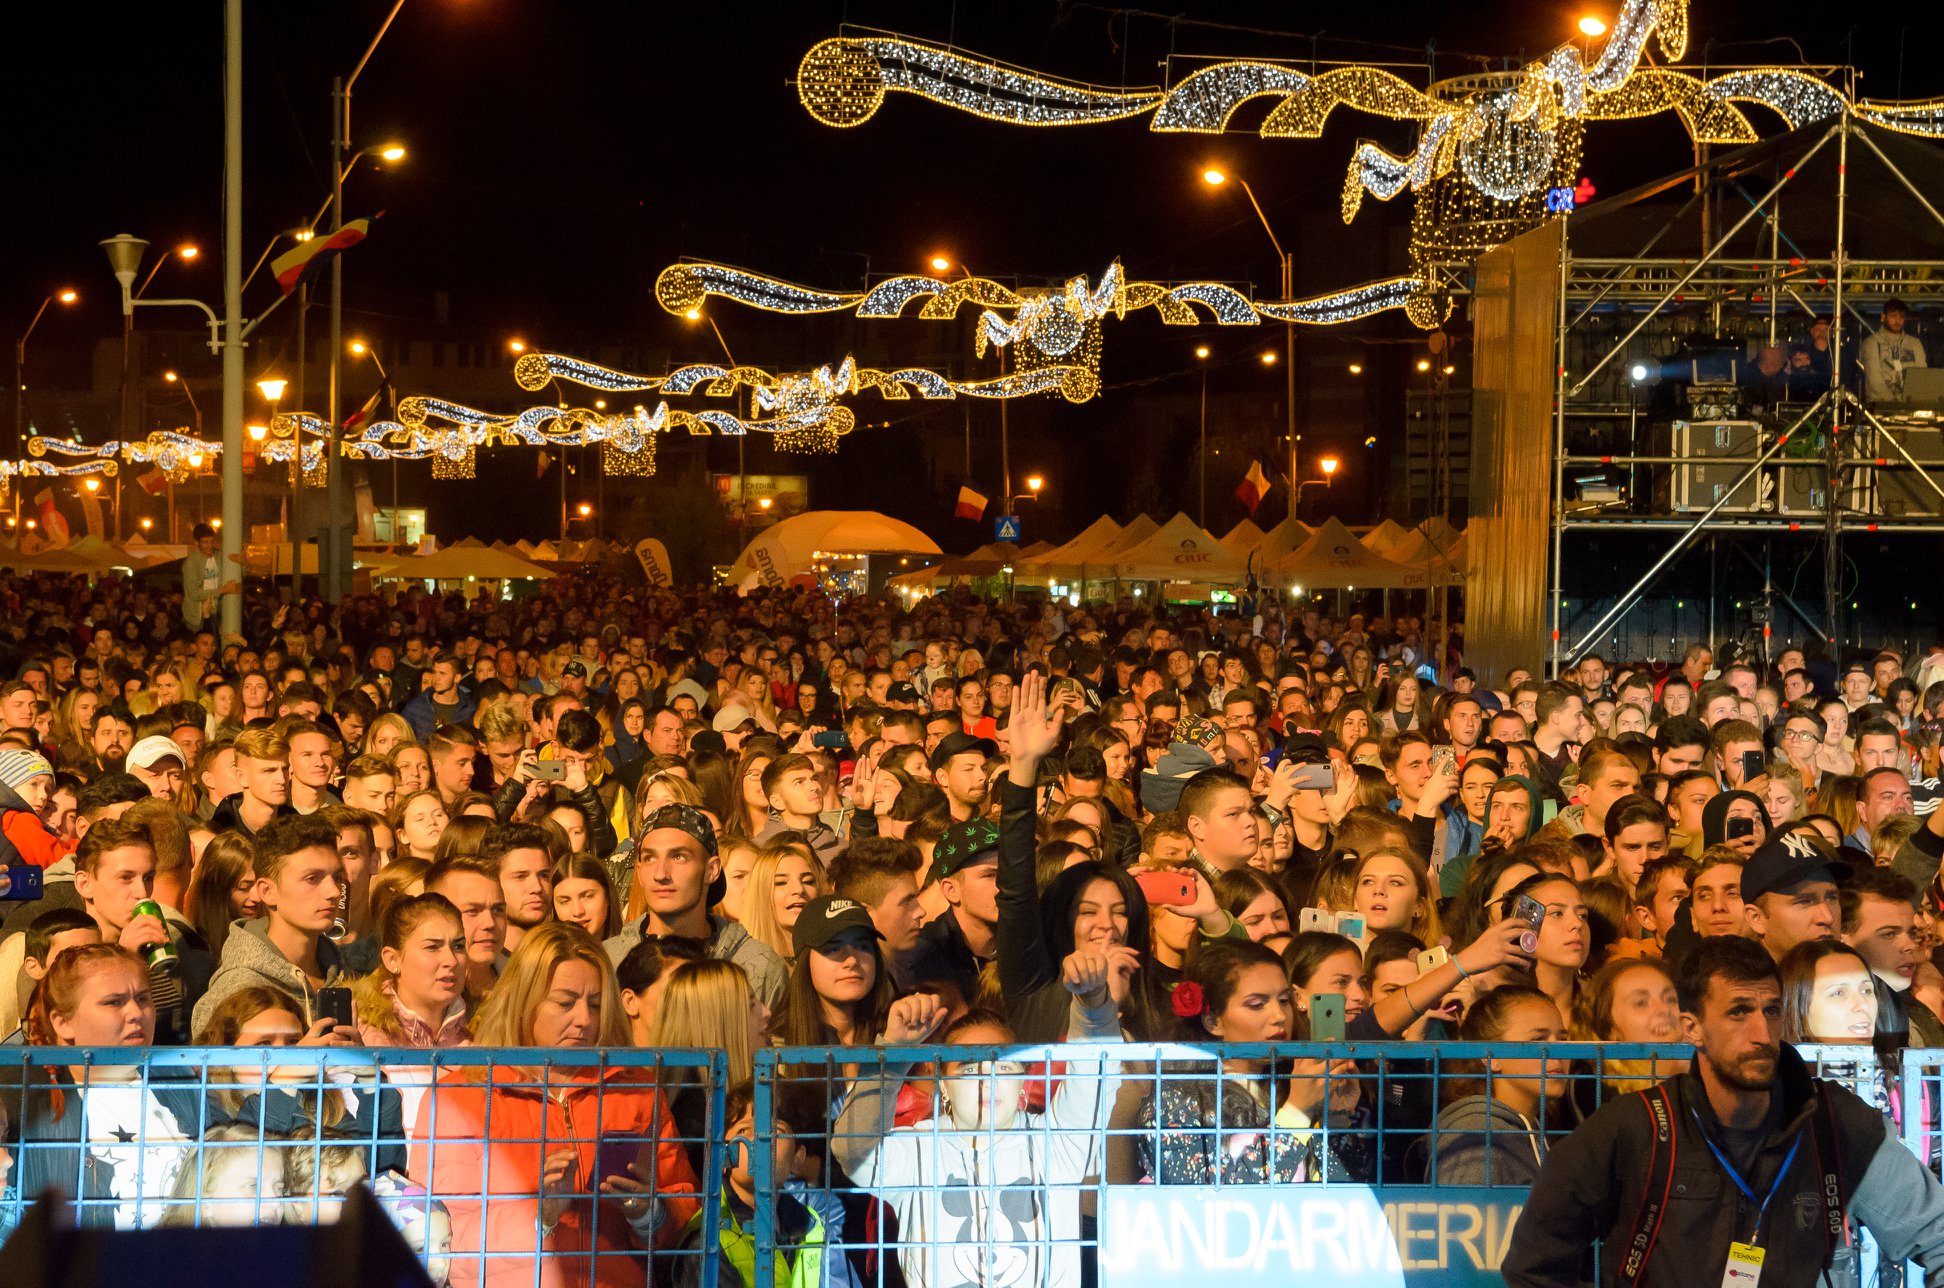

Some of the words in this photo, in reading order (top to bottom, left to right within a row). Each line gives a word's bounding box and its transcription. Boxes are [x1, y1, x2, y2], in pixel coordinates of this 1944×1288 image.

[830, 899, 853, 911] NIKE
[1651, 1099, 1670, 1142] Canon
[1826, 1173, 1839, 1207] EOS
[1625, 1248, 1642, 1278] EOS
[1732, 1251, 1761, 1263] TEHNIC
